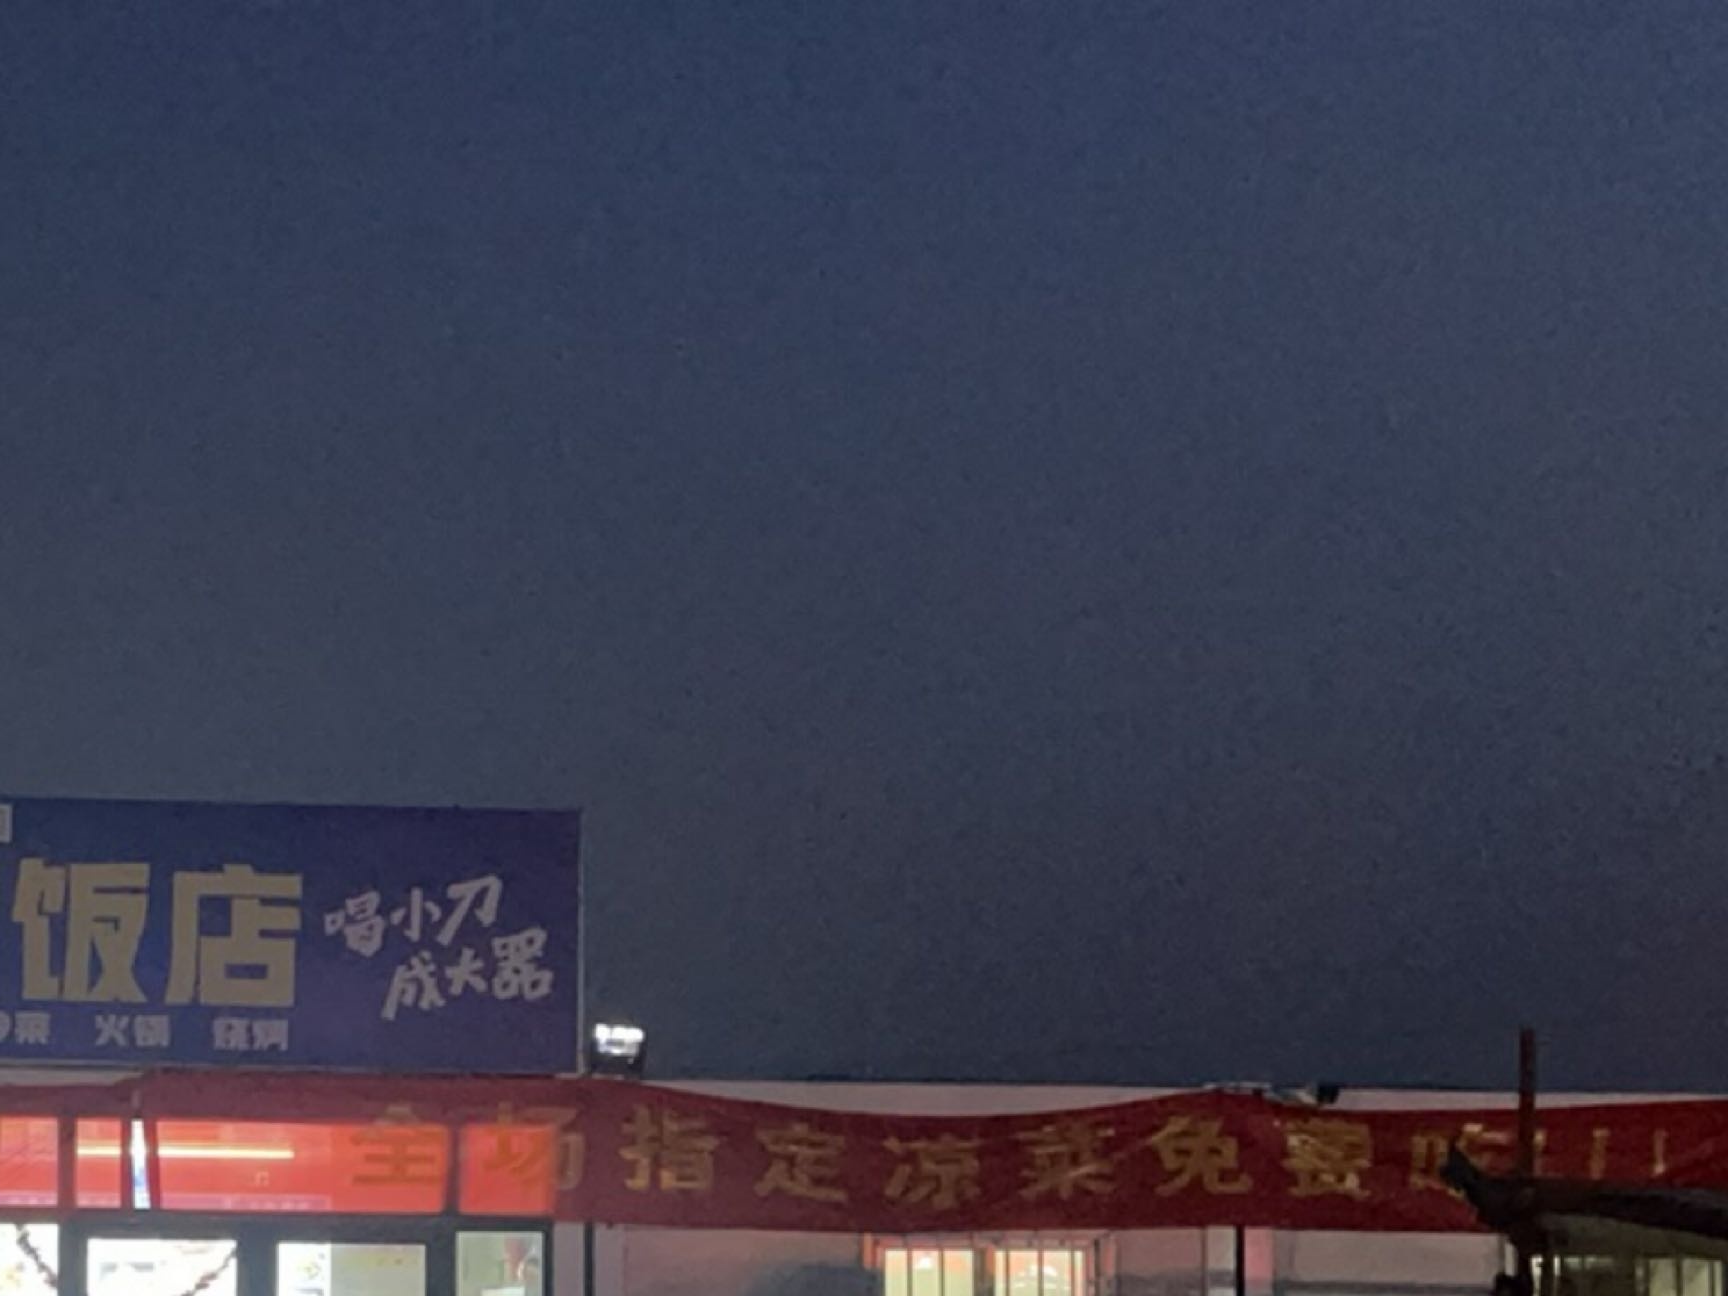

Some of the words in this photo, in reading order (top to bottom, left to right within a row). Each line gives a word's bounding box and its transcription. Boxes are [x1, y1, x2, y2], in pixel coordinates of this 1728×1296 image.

[324, 874, 502, 957] 喝小刀
[380, 927, 554, 1021] 成大器
[94, 1014, 170, 1048] 火锅
